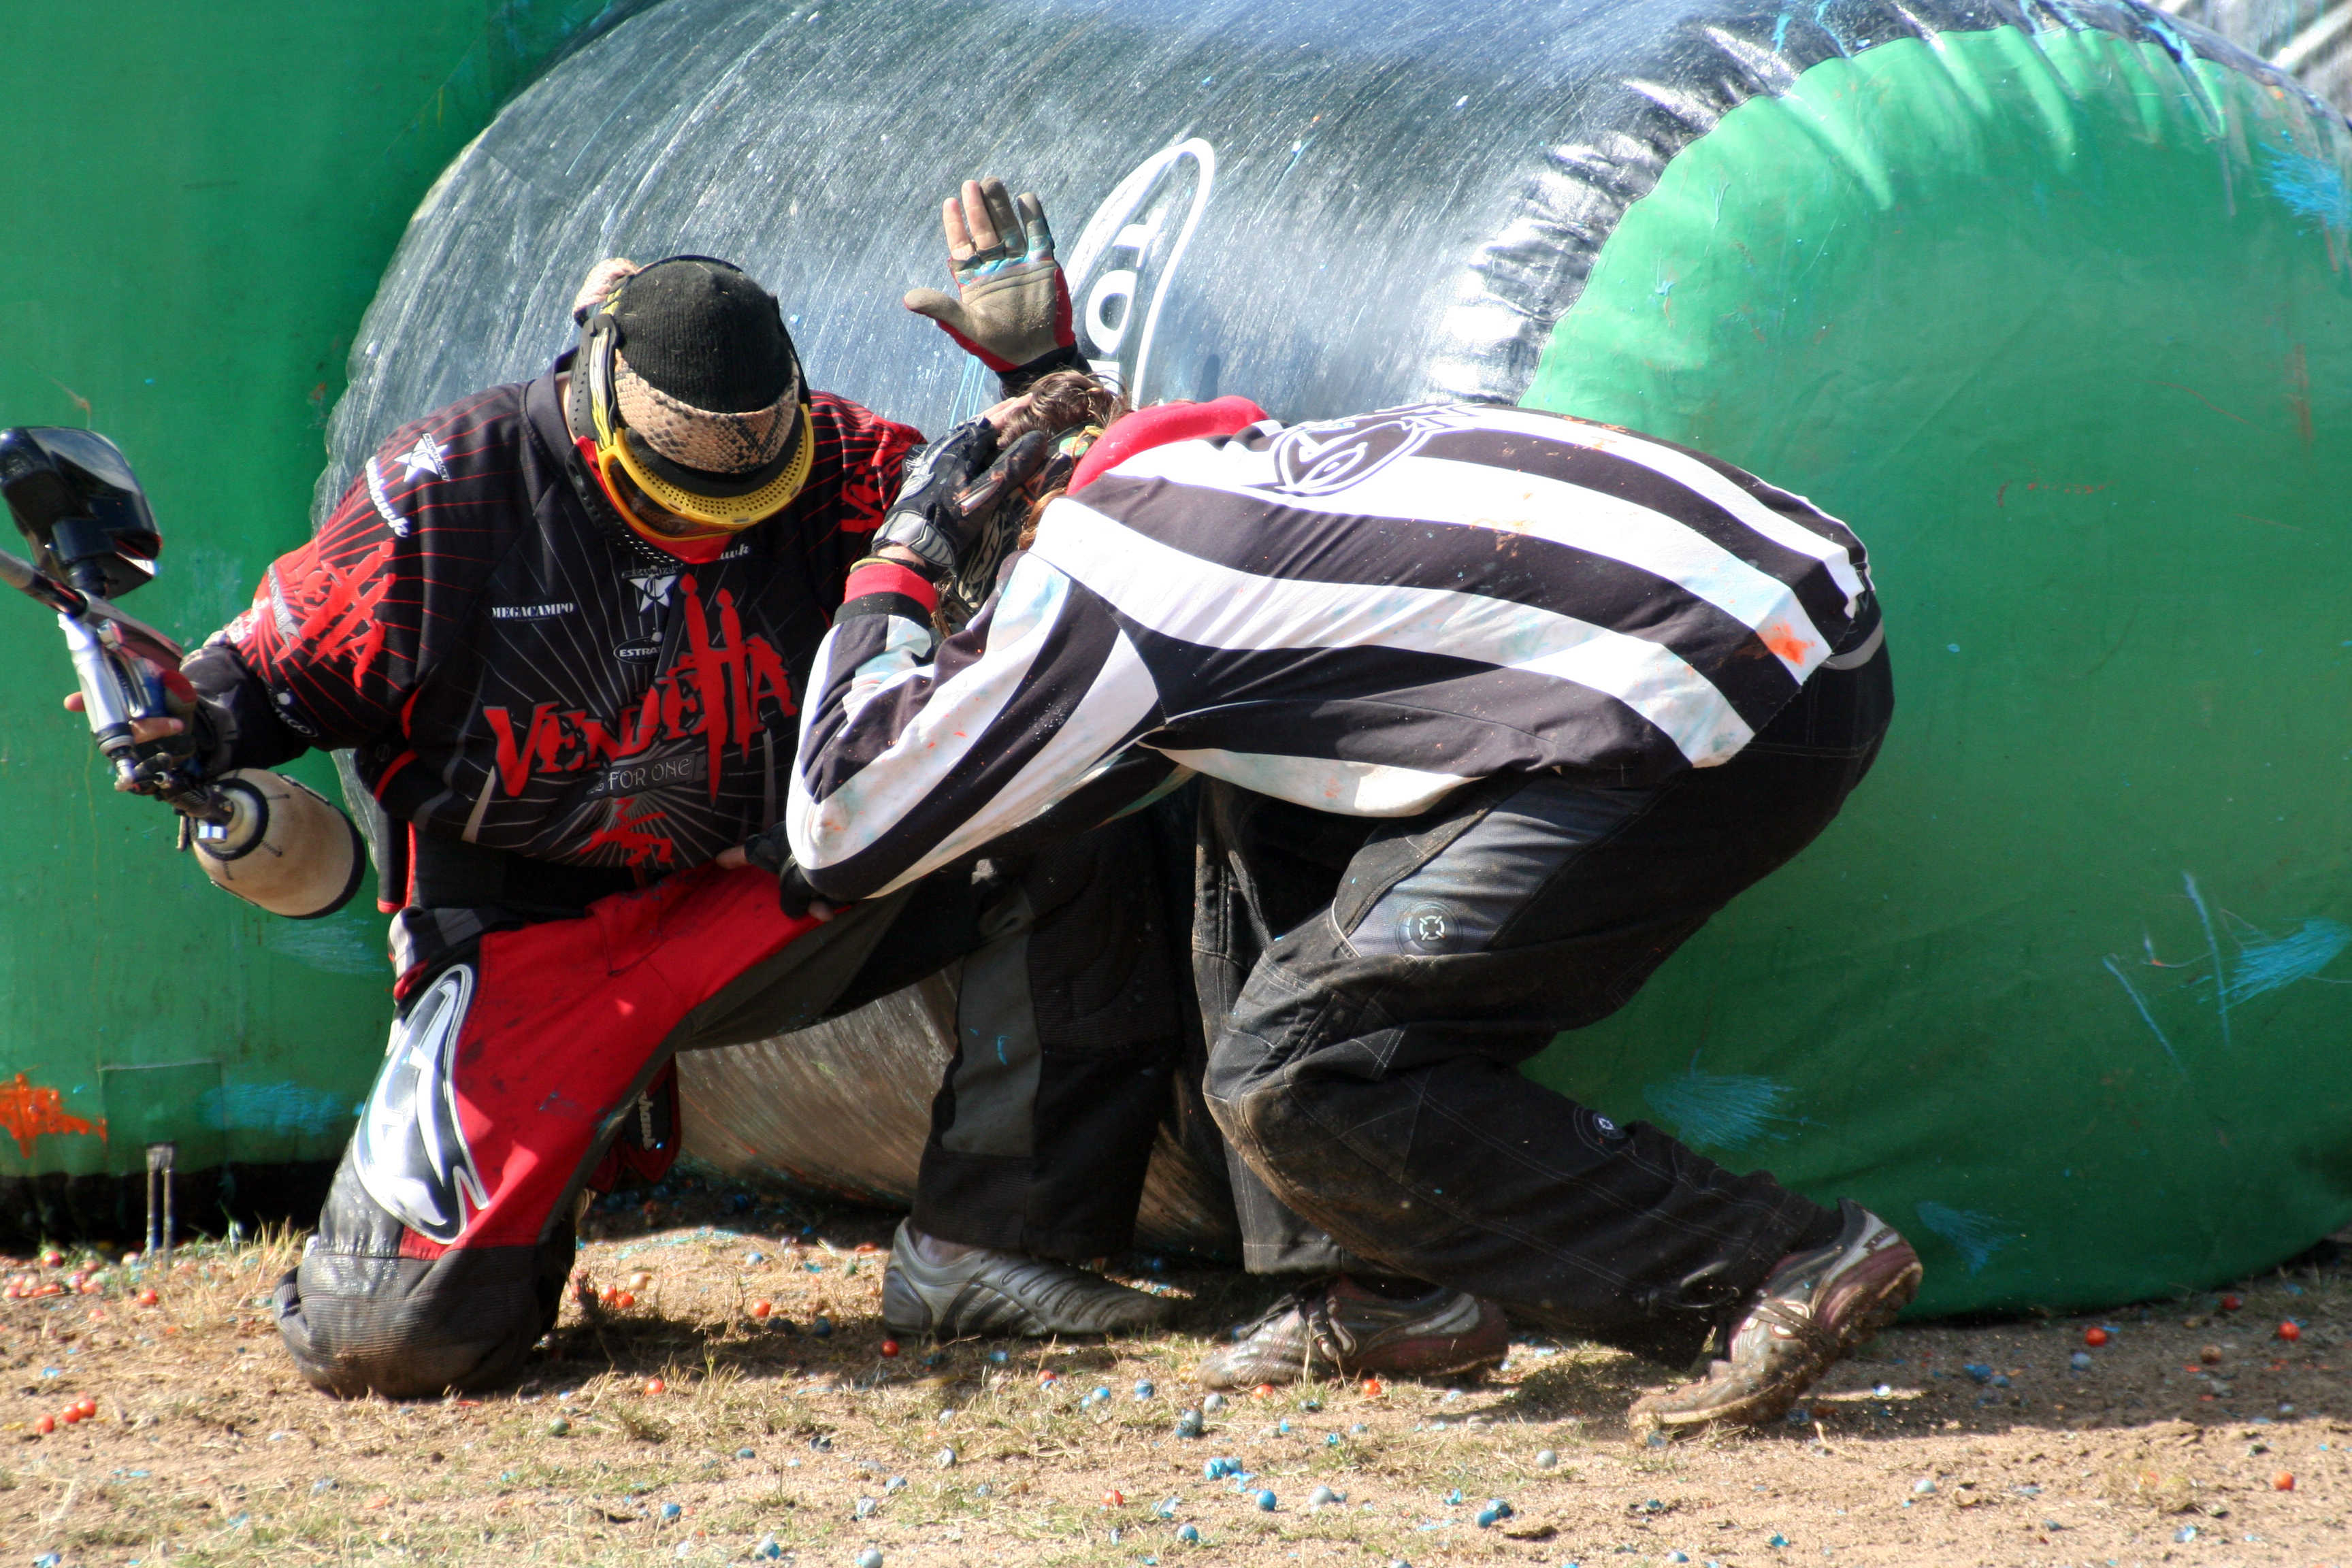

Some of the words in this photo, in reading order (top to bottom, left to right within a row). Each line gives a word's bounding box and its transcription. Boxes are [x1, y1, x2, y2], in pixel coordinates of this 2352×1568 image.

[491, 602, 574, 618] MEGACAMPO
[607, 768, 647, 791] FOR
[651, 758, 693, 781] ONE
